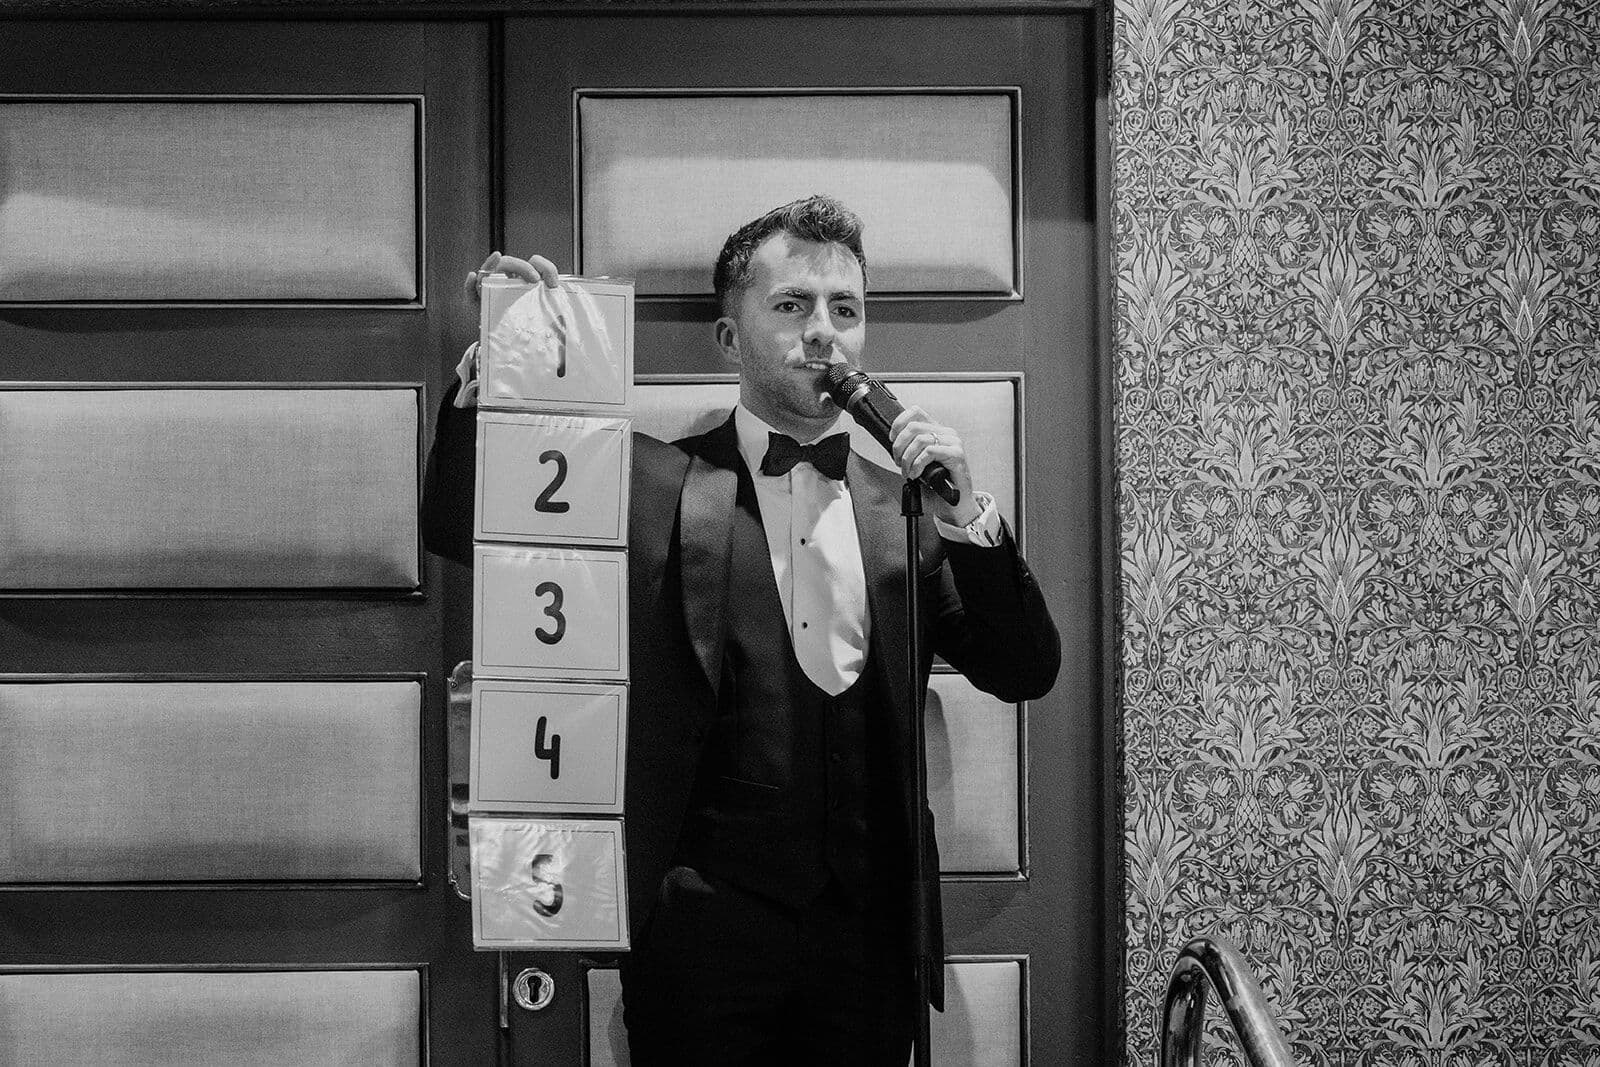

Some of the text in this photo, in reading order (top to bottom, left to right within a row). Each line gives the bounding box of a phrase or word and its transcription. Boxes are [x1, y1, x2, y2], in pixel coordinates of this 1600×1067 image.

[550, 314, 567, 378] 1
[534, 450, 570, 514] 2
[535, 581, 566, 645] 3
[534, 716, 561, 780] 4
[531, 854, 564, 918] 5
